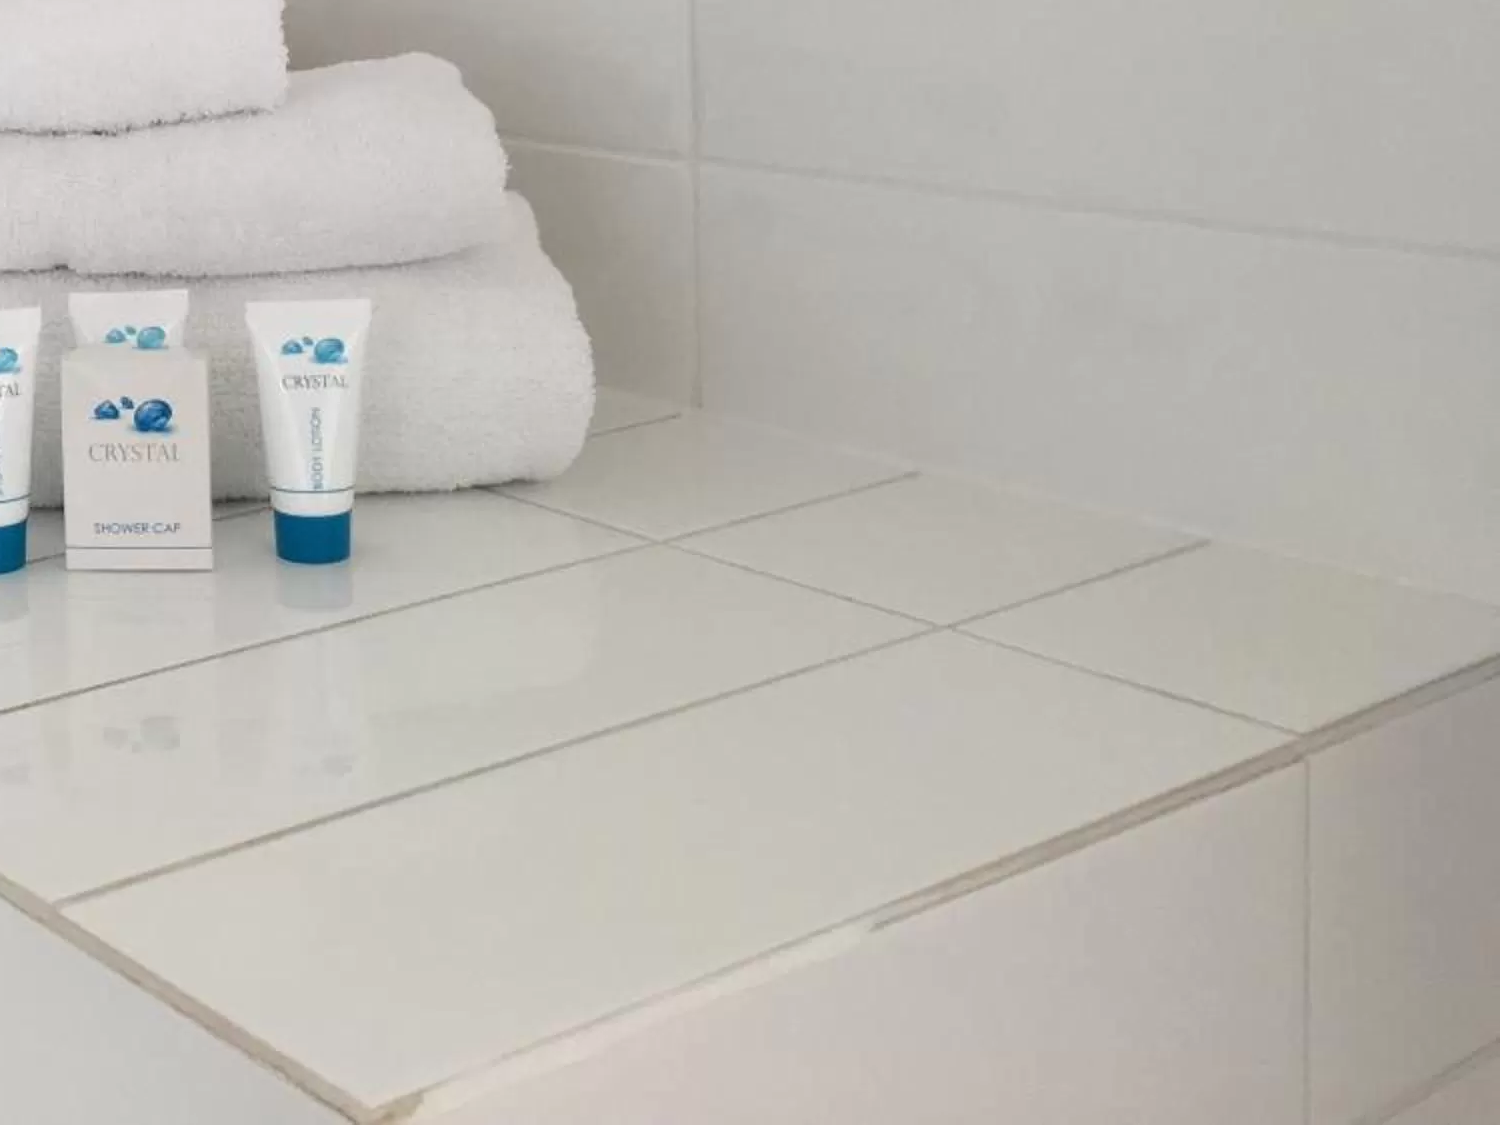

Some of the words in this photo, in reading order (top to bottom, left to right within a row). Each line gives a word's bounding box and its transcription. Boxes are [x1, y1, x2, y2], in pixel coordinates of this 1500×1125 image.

[280, 374, 349, 391] CRYSTAL
[310, 406, 323, 452] LOTION
[88, 442, 181, 463] CRYSTAL
[311, 456, 324, 490] BODY
[94, 522, 149, 535] SHOWER
[151, 522, 182, 535] CAP
